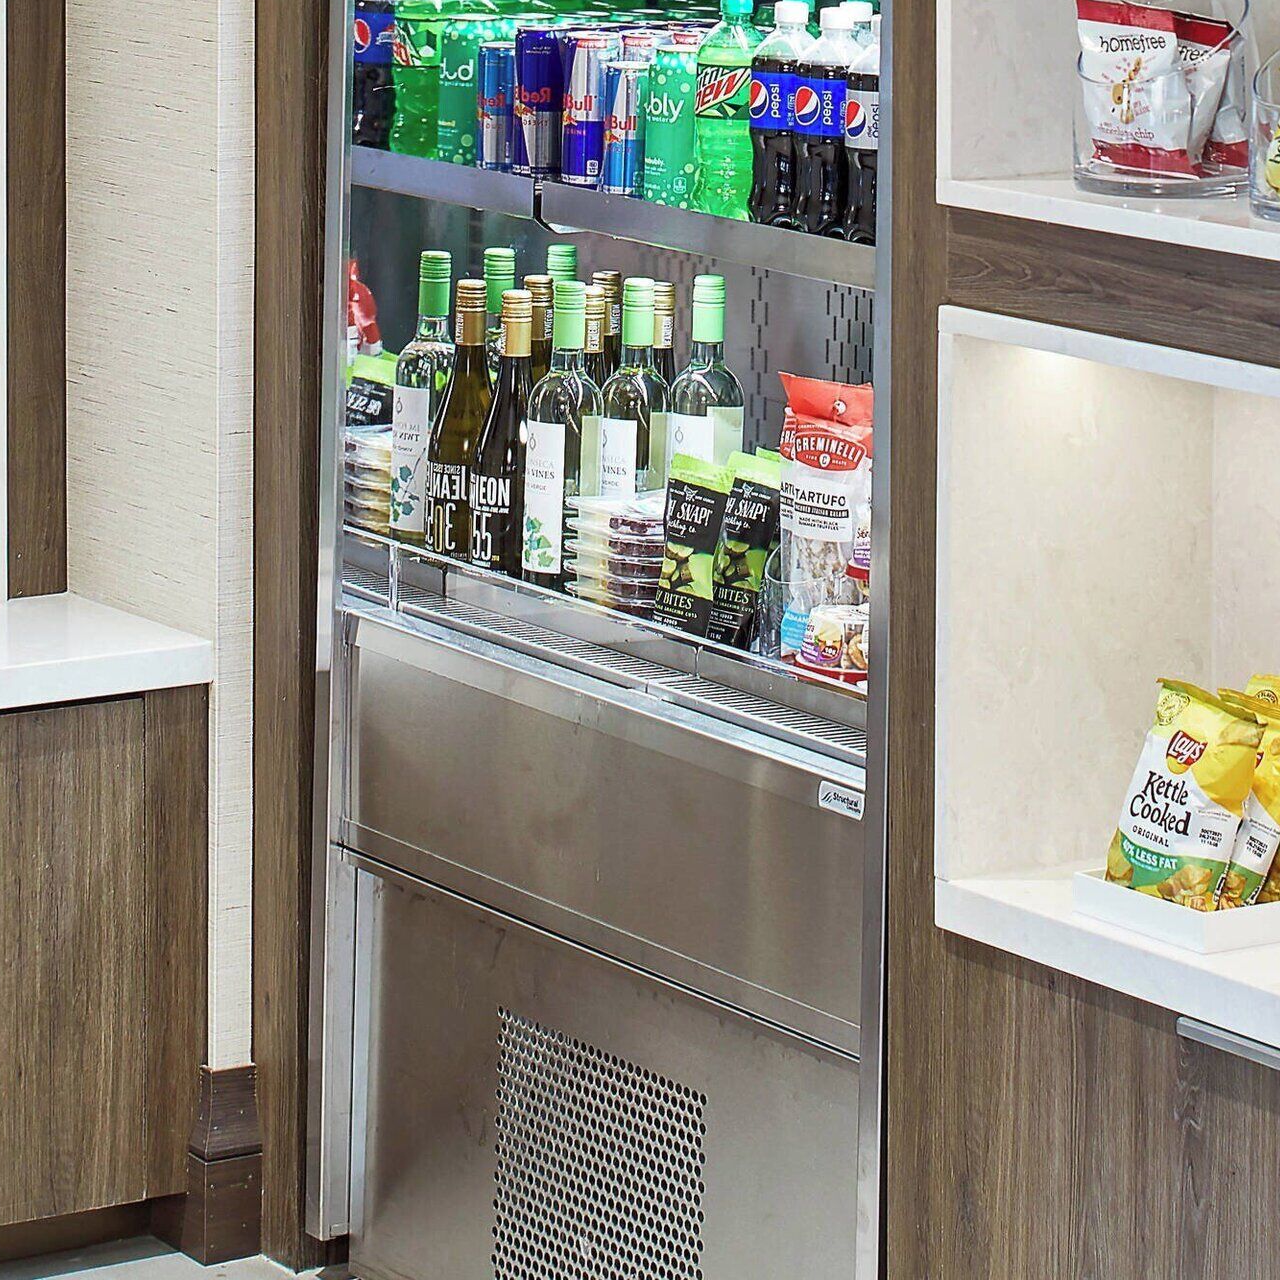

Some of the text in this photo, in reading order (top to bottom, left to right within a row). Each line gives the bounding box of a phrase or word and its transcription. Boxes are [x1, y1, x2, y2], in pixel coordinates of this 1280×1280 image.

[1099, 35, 1166, 53] homefree
[770, 83, 782, 118] pepsi
[822, 90, 834, 126] pepsi
[1134, 128, 1155, 142] chip
[796, 437, 862, 463] CREMINELLI
[531, 469, 555, 480] VINES
[602, 464, 627, 475] VINES
[795, 488, 846, 507] TARTUFO
[663, 592, 694, 610] BITES
[718, 590, 751, 604] BITES
[1142, 770, 1190, 806] Kettle
[1129, 794, 1192, 836] Cooked
[1132, 825, 1170, 848] ORIGINAL
[1135, 848, 1158, 867] LESS
[1158, 855, 1178, 870] FAT
